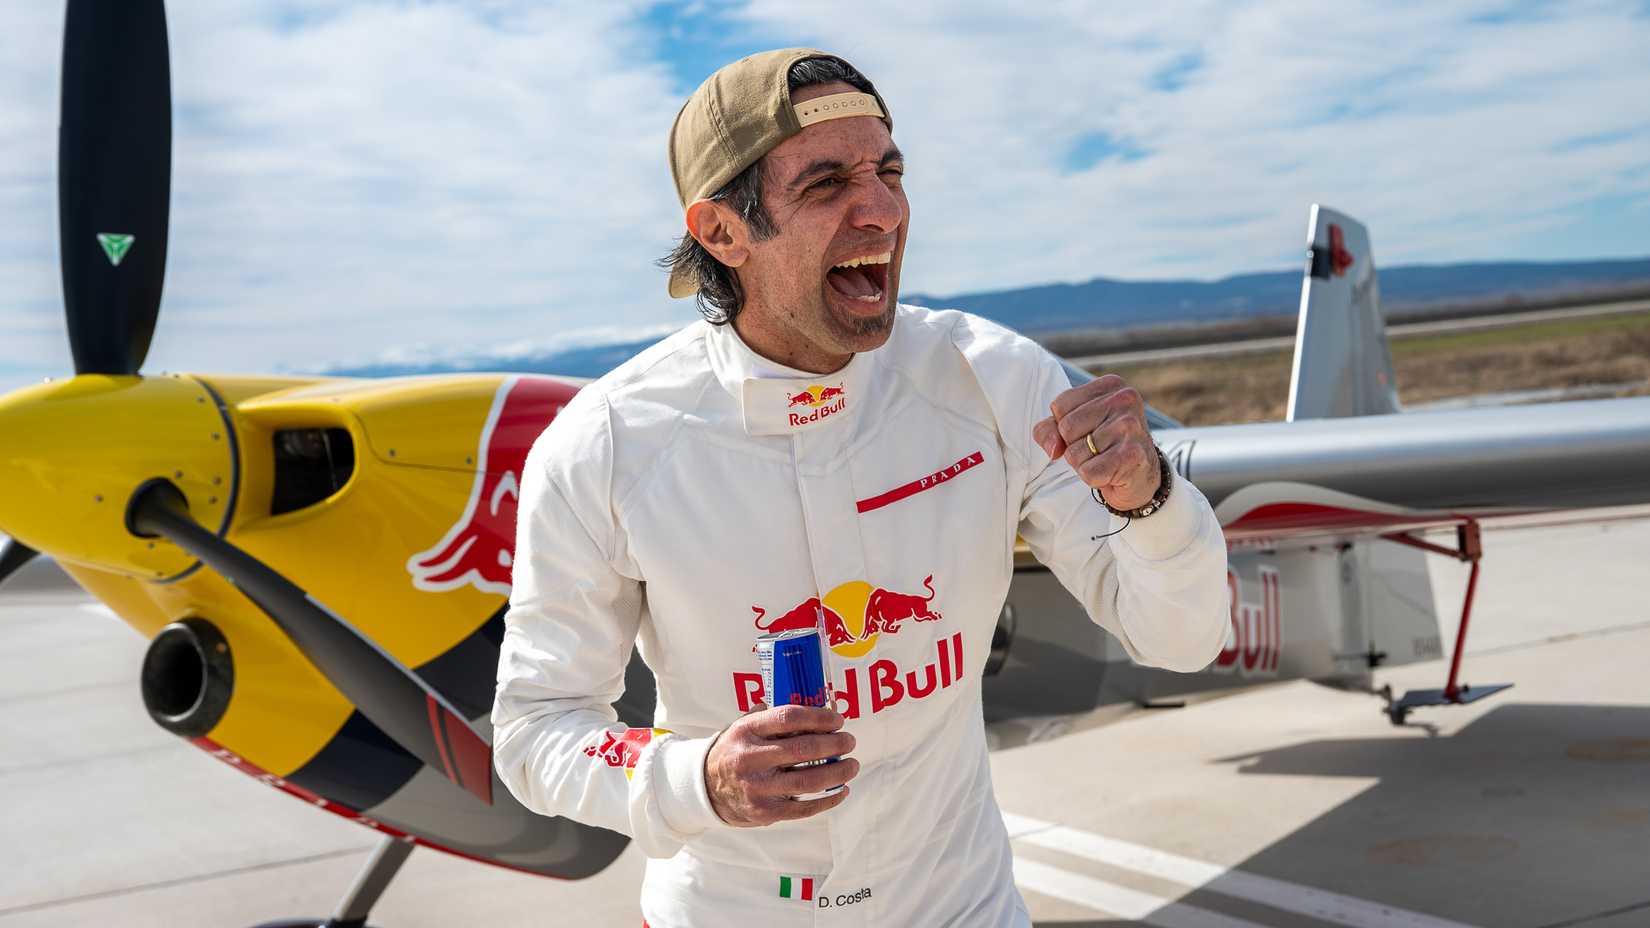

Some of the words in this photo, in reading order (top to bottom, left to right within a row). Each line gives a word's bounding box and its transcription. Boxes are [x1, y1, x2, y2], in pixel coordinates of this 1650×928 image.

[789, 409, 819, 426] Red
[820, 397, 846, 419] Bull
[919, 456, 976, 488] PRADA
[732, 667, 861, 720] Rd
[868, 631, 964, 714] Bull
[818, 896, 833, 909] D.
[835, 887, 873, 907] Costa
